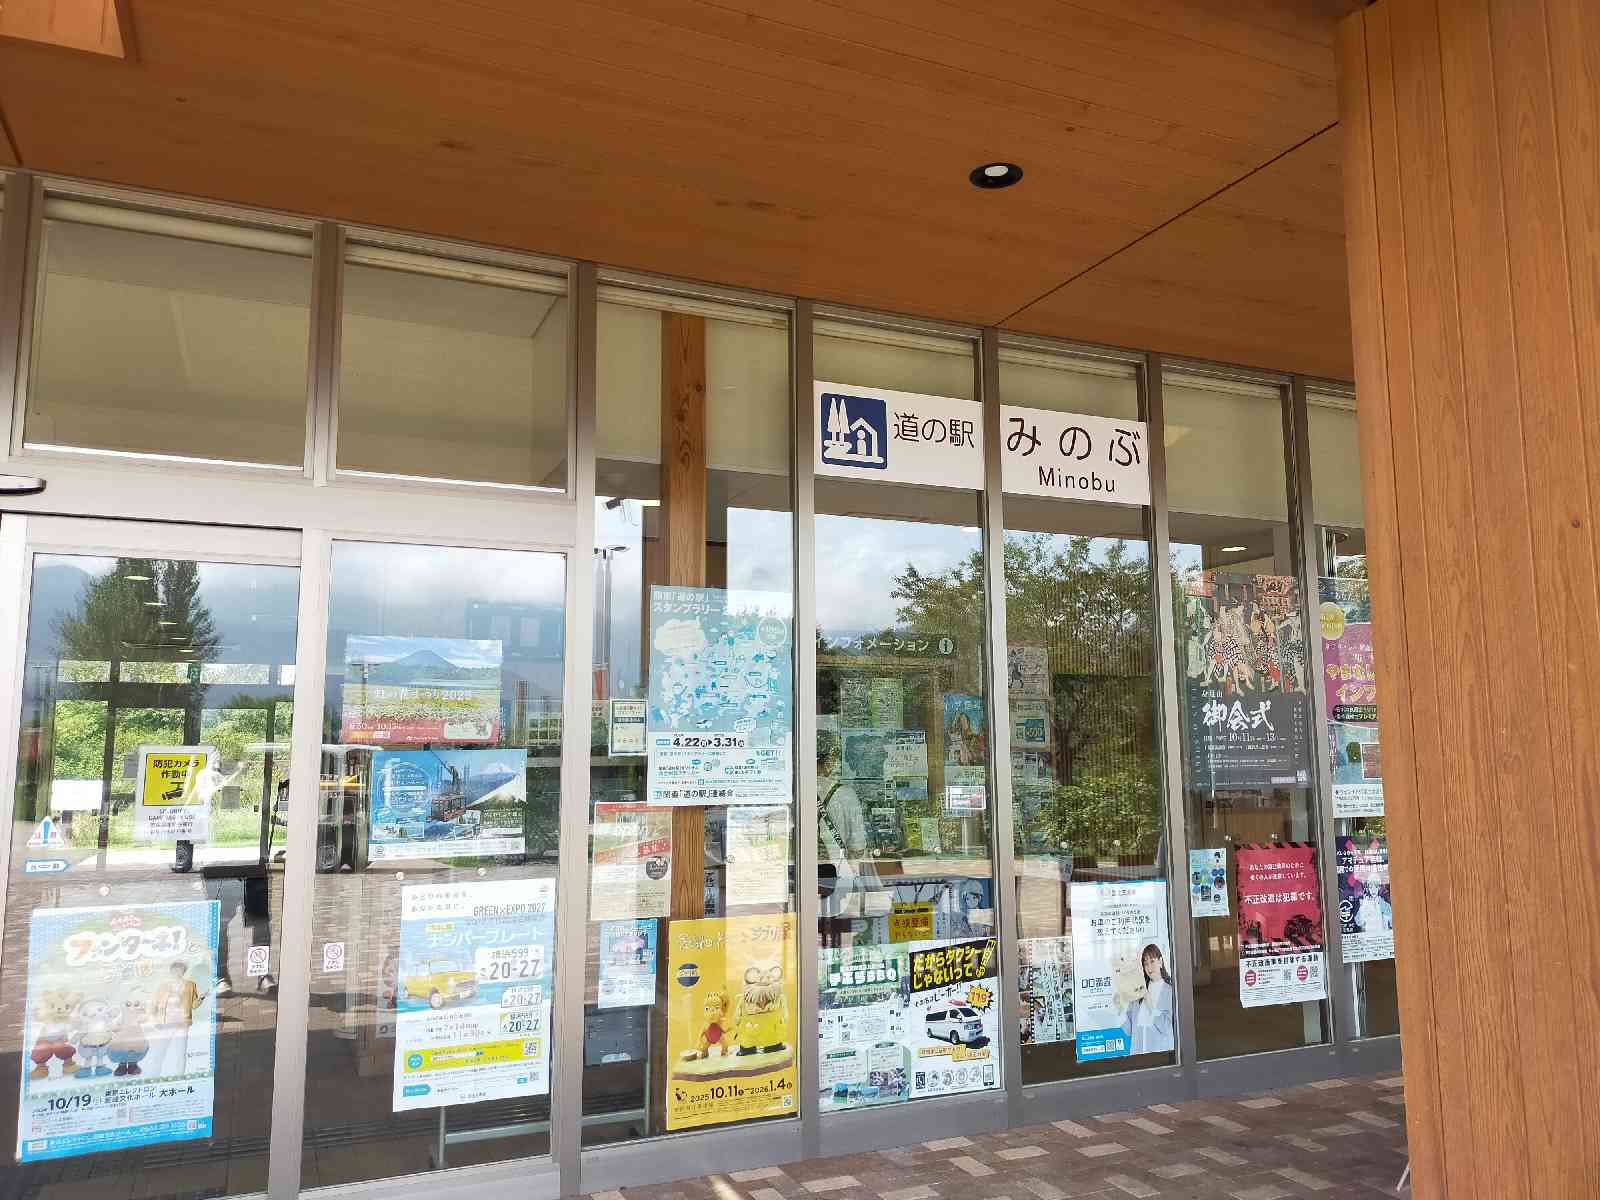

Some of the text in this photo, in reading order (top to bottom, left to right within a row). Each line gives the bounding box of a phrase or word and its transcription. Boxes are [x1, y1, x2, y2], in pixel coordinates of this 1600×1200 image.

[893, 411, 975, 449] 道の駅
[1006, 417, 1141, 467] みのぶ
[1038, 466, 1116, 493] Minobu
[1202, 700, 1275, 733] 御会式
[672, 736, 738, 748] 4.22 3.31
[153, 759, 200, 769] 防犯カメラ
[913, 963, 973, 990] じゃないって
[159, 1086, 195, 1098] 大ホール
[710, 1084, 737, 1099] 10.11
[769, 1078, 786, 1092] 1.4
[47, 1093, 92, 1111] 10/19
